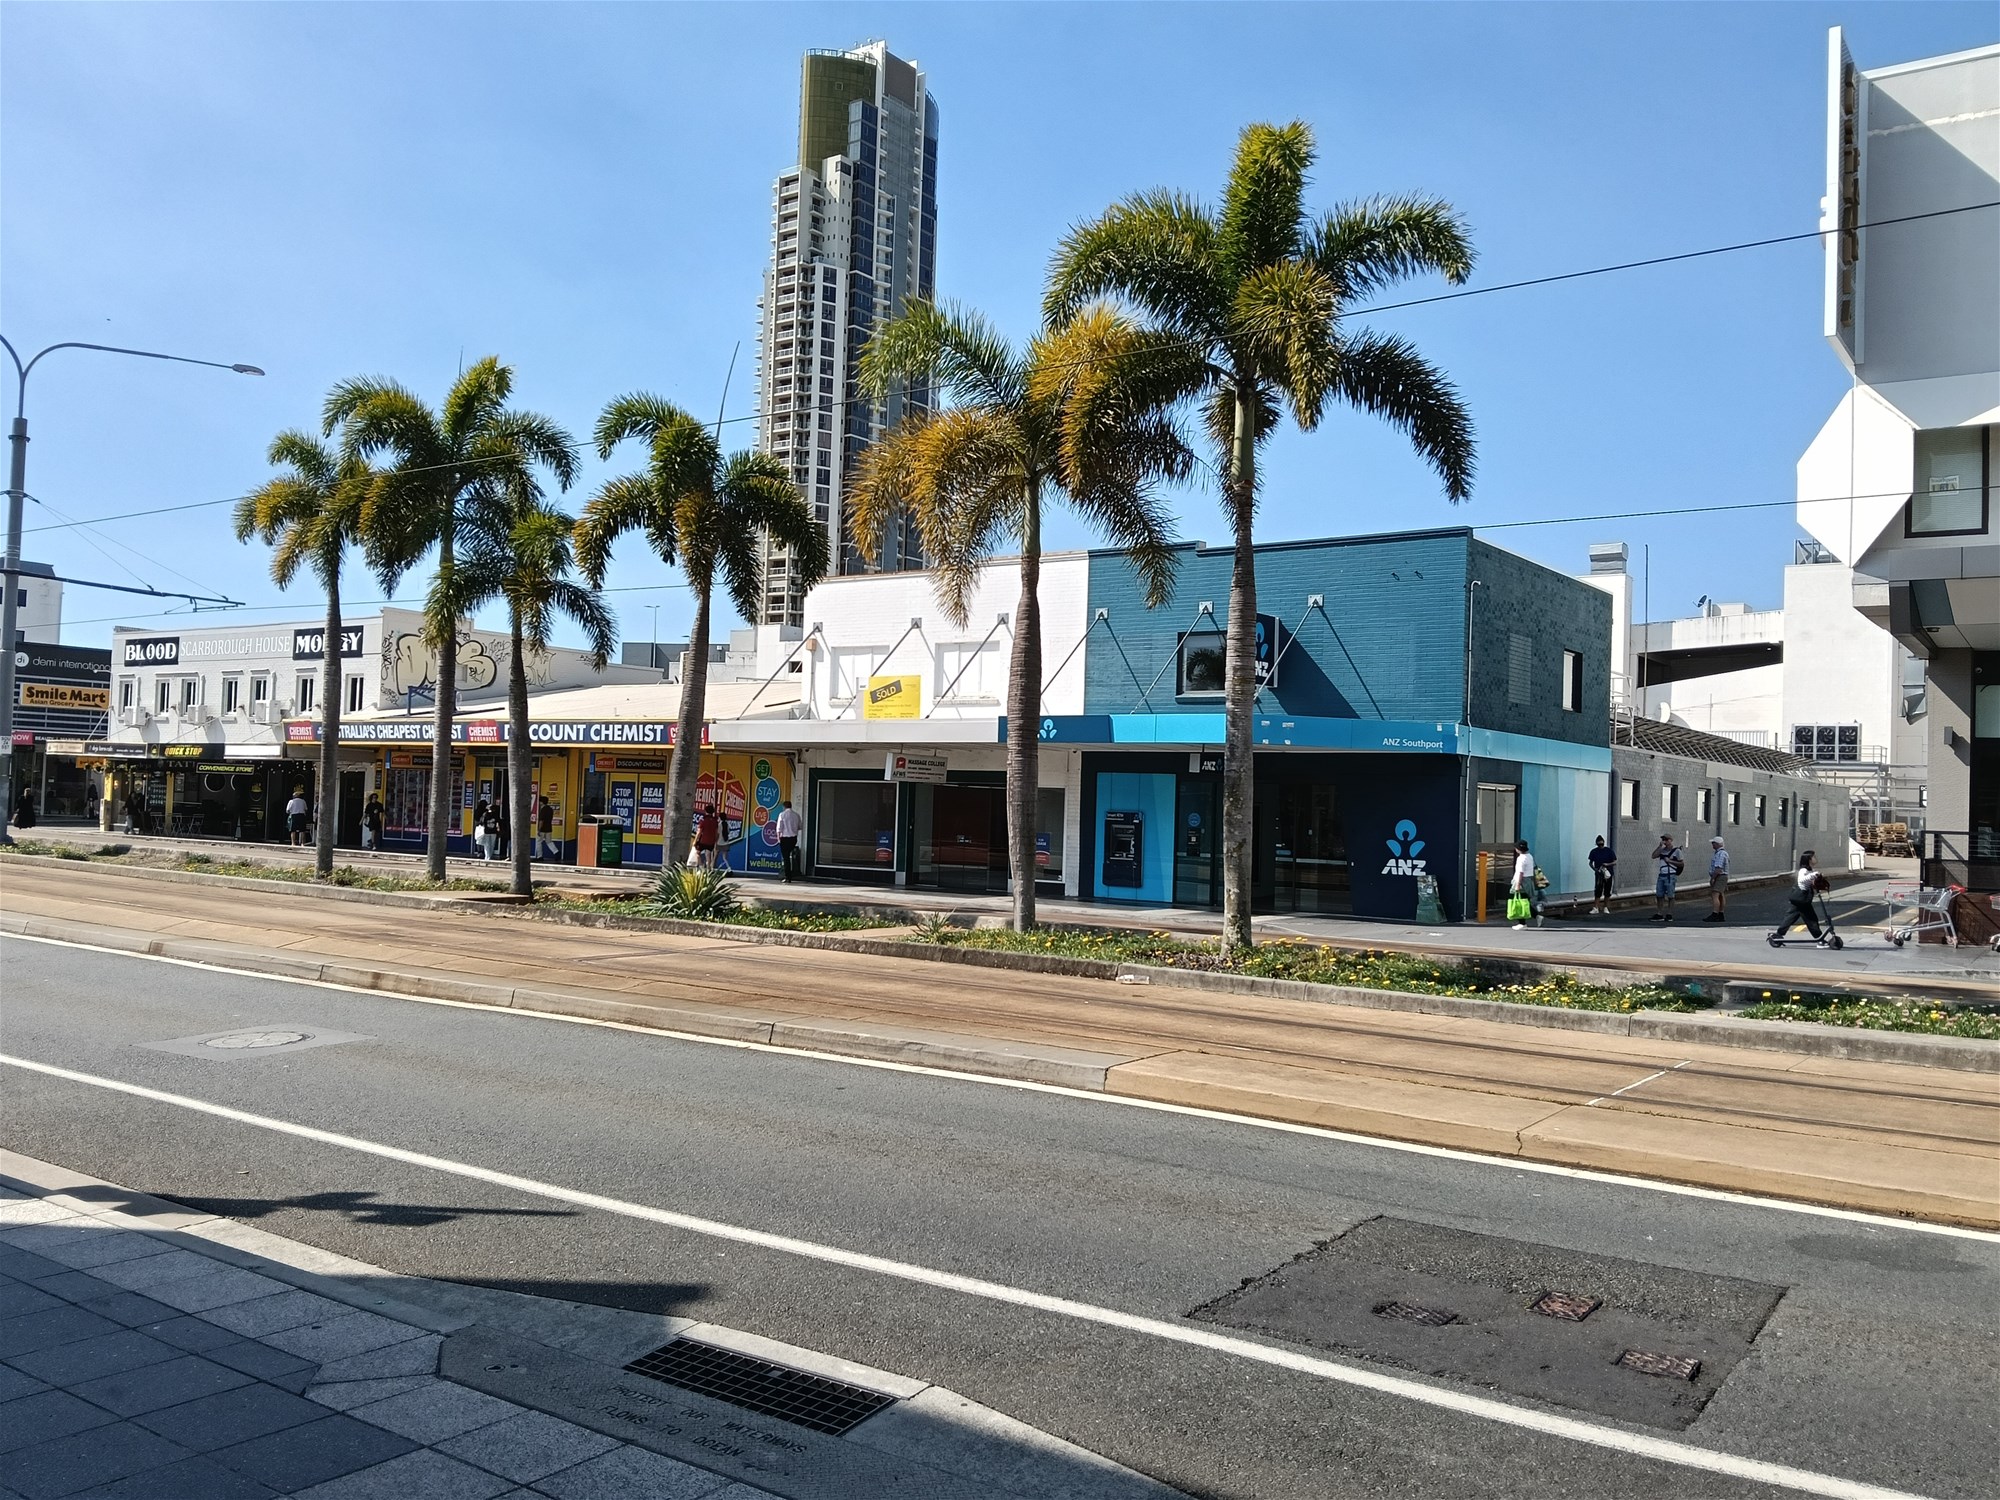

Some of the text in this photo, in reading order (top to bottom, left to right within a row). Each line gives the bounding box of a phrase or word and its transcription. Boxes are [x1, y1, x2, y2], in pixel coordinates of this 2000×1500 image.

[180, 635, 291, 657] SCARBOROUGH HOUSE
[296, 632, 362, 654] MOEY
[125, 642, 177, 661] BLOOD
[33, 656, 57, 667] demi
[1254, 660, 1269, 678] NZ
[26, 686, 106, 703] Smile Mart
[876, 685, 898, 701] SOLD
[289, 726, 313, 737] CHEMIST
[338, 725, 376, 740] TRALIA'S
[376, 724, 421, 740] CHEAPEST
[422, 724, 462, 740] CHST
[468, 726, 498, 738] CHEMIST
[590, 723, 664, 742] CHEMIST
[1382, 738, 1443, 750] ANZ Southport
[164, 747, 203, 756] QUICK STOP
[198, 764, 234, 773] CONVENIENCE
[617, 760, 664, 769] DISCOUNT CHEMIST
[756, 763, 770, 773] GET
[908, 759, 927, 767] MASSAGE
[1201, 761, 1217, 771] ANZ
[615, 788, 631, 797] STOP
[643, 787, 662, 796] REAL
[758, 786, 778, 798] STAY
[612, 797, 634, 807] PAYING
[616, 807, 629, 816] TOO
[756, 812, 768, 820] LIVE
[642, 814, 662, 823] REAL
[749, 857, 782, 869] wellness
[1381, 858, 1427, 877] ANZ
[611, 1384, 809, 1456] PROTECT OUR WATERWAYS
[599, 1405, 746, 1458] FLOWS TO OCEAN
